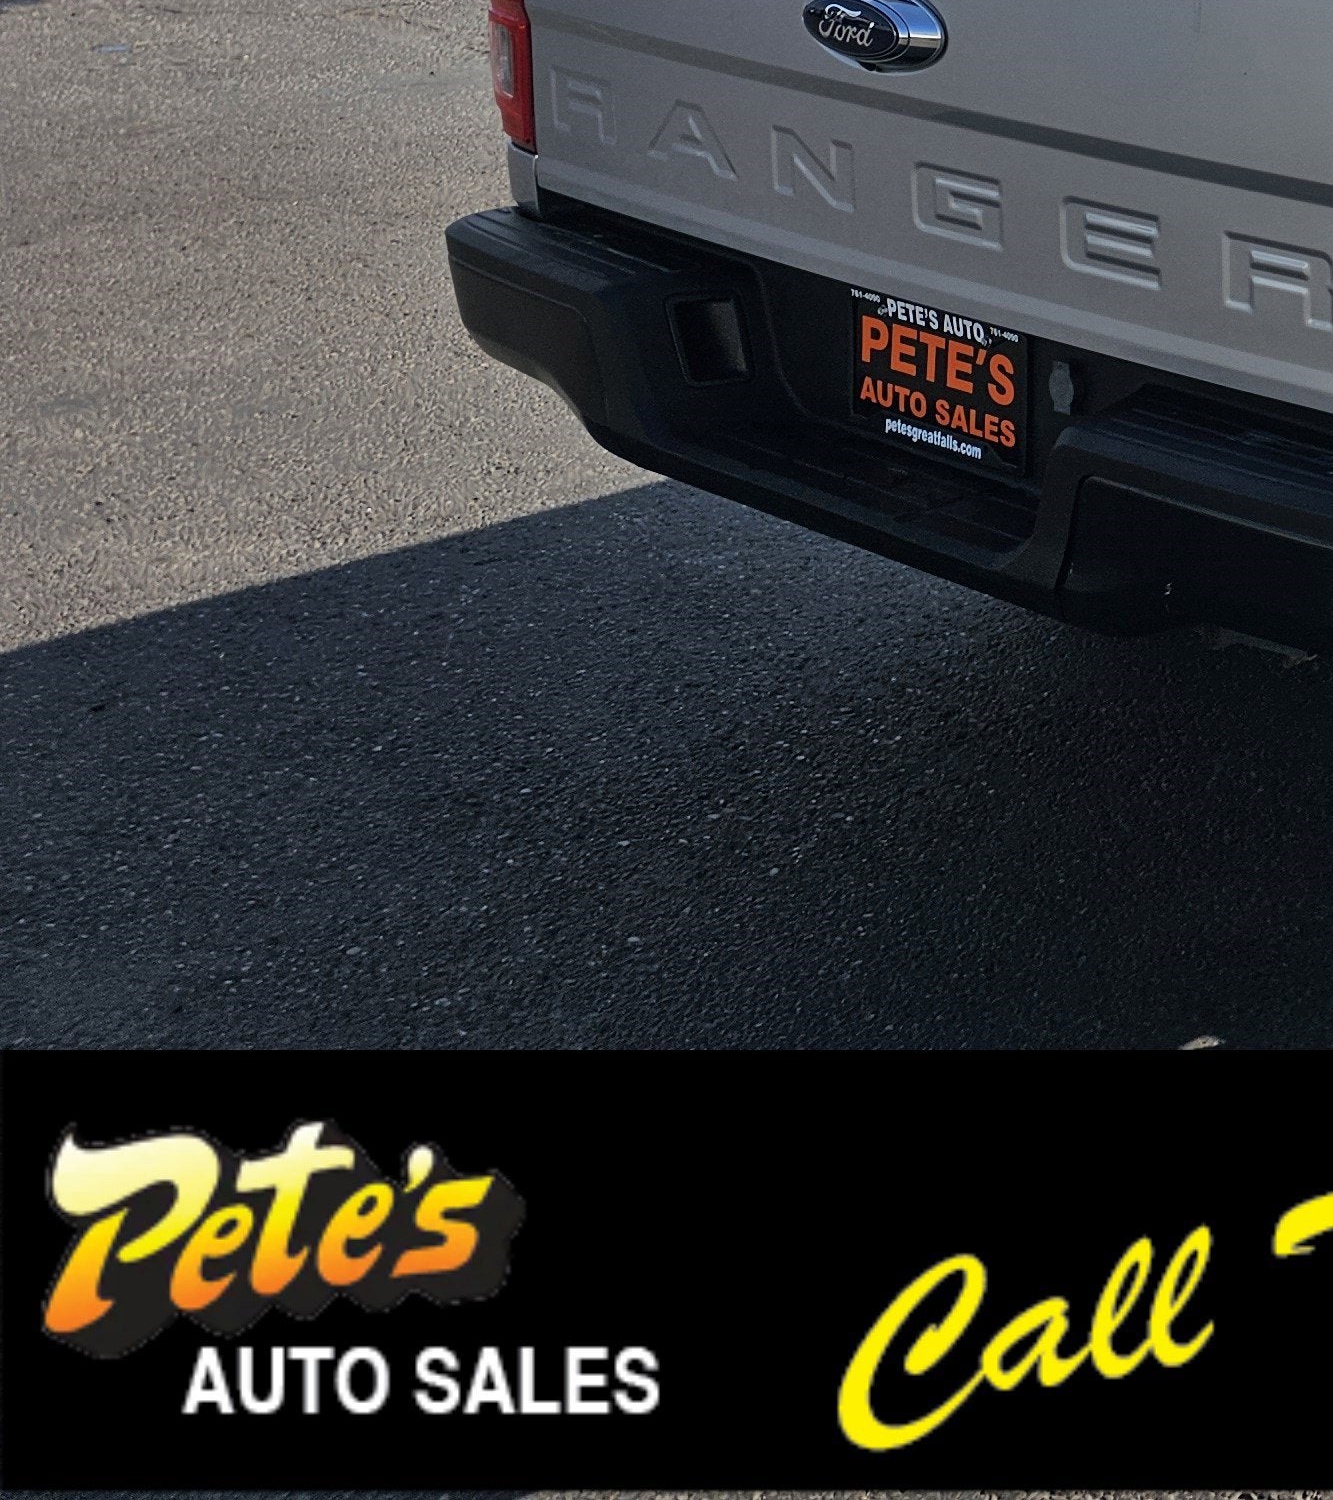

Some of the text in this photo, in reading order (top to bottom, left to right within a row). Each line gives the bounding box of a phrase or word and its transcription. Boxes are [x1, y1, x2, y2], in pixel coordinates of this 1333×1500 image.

[818, 3, 875, 47] Ford
[886, 298, 985, 346] PETE'S AUTO
[861, 315, 1015, 406] PETE'S
[860, 375, 1016, 448] AUTO SALES
[885, 418, 982, 460] petesgreatfalls.com
